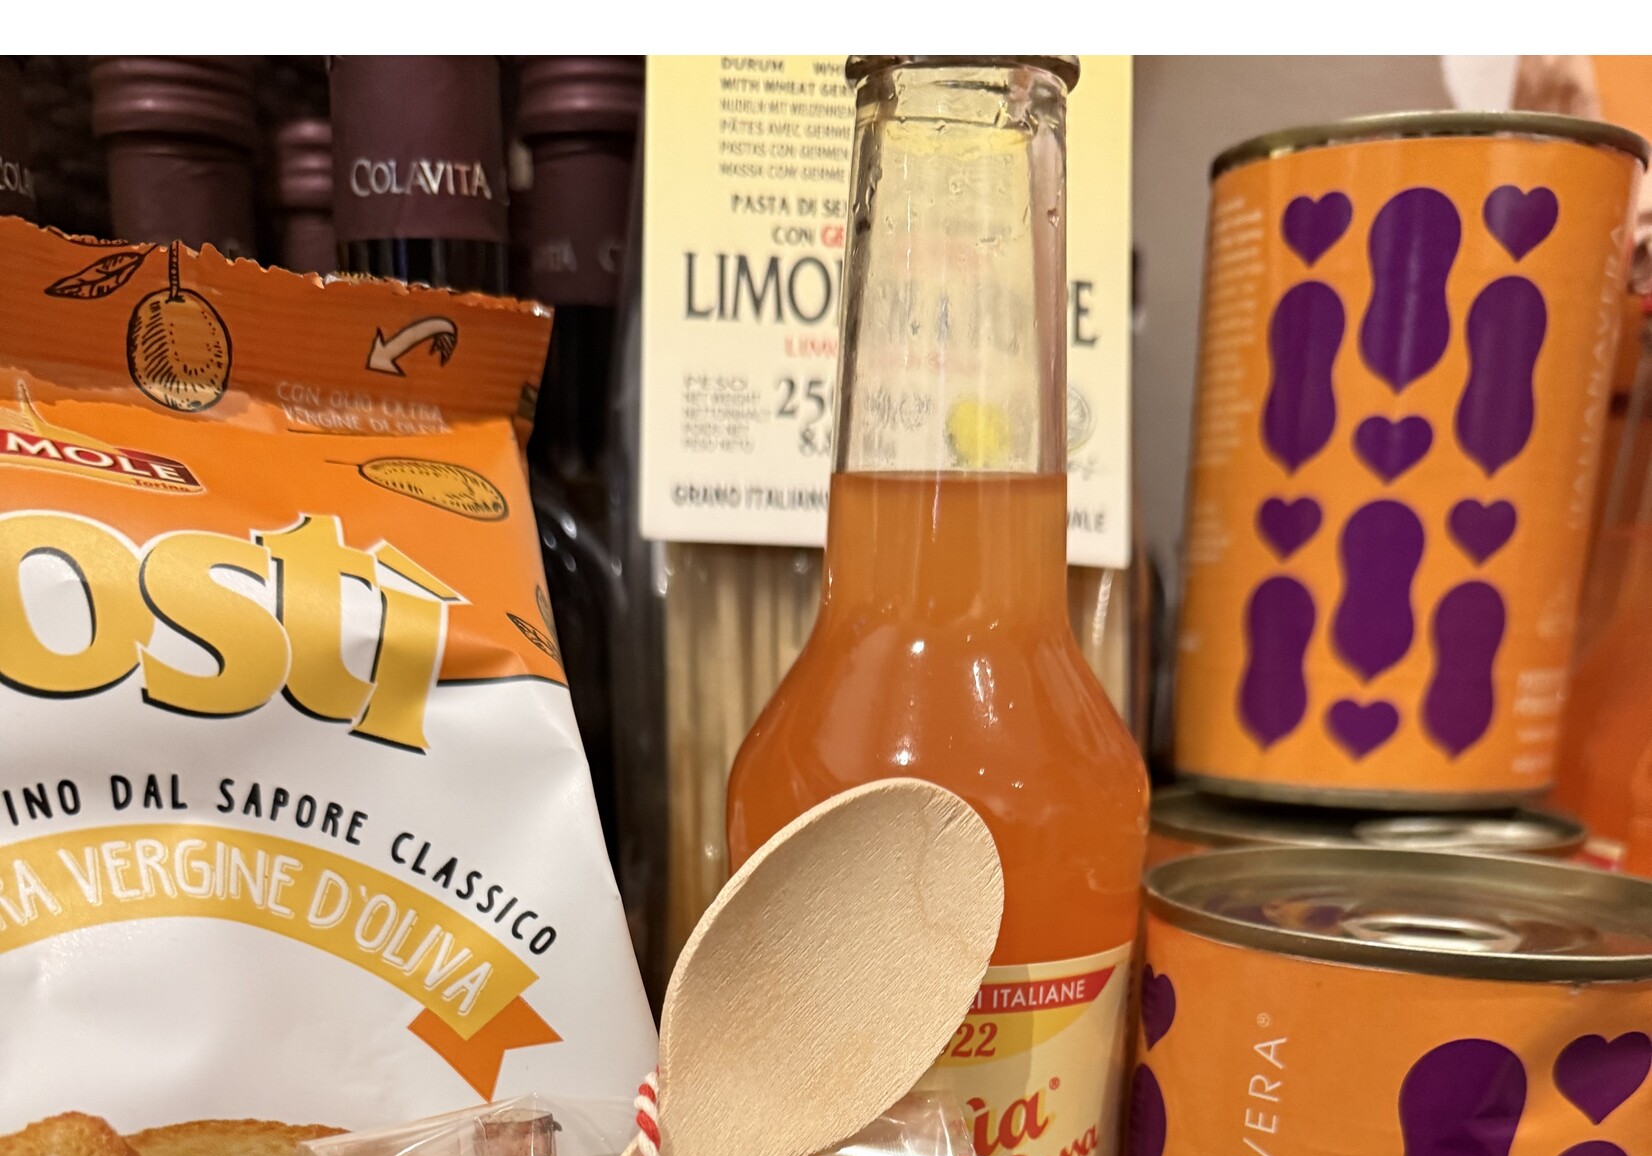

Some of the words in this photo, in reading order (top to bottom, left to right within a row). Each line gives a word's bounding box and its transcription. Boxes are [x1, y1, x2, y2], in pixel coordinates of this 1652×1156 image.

[351, 158, 492, 200] COLAVITA
[731, 194, 790, 216] PASTA
[797, 197, 817, 217] DI
[771, 224, 814, 247] CON
[277, 380, 320, 405] CON
[775, 376, 836, 425] 25
[6, 432, 187, 484] MOLE
[671, 484, 742, 507] GRANO
[2, 779, 82, 827] INO
[109, 773, 189, 812] DAL
[217, 778, 369, 846] SAPORE
[390, 832, 558, 957] CLASSICO
[56, 837, 303, 919] VERGINE
[991, 979, 1087, 1009] ITALIANE
[941, 1021, 998, 1059] 22
